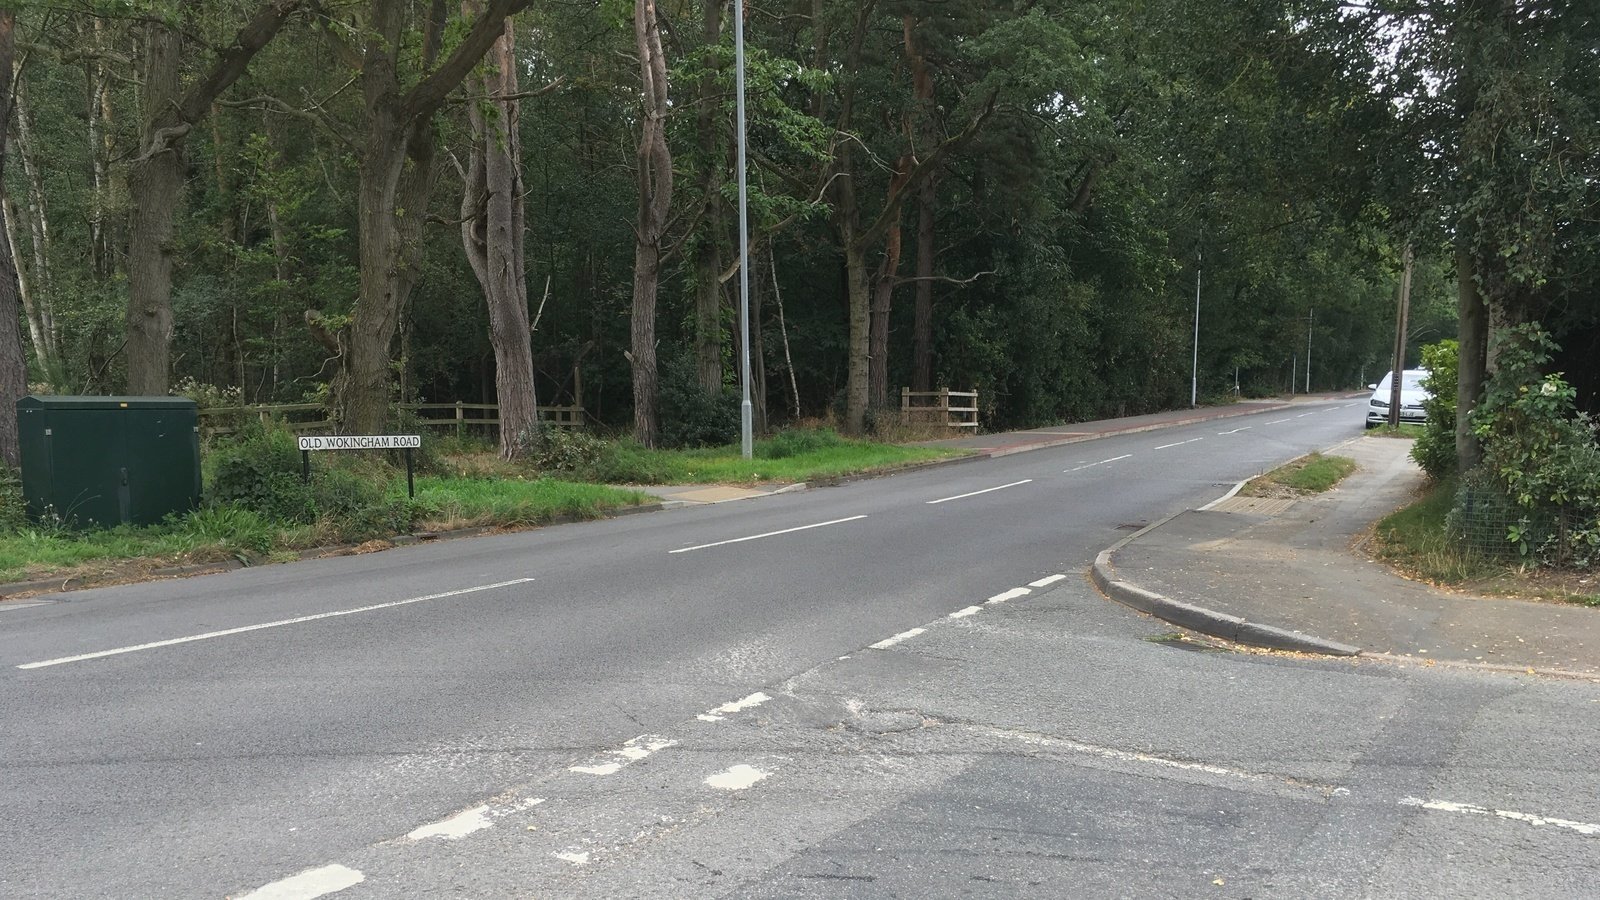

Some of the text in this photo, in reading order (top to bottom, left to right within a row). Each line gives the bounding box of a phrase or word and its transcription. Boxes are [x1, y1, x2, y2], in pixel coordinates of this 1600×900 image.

[300, 436, 419, 448] OLD WOKINGHAM ROAD
